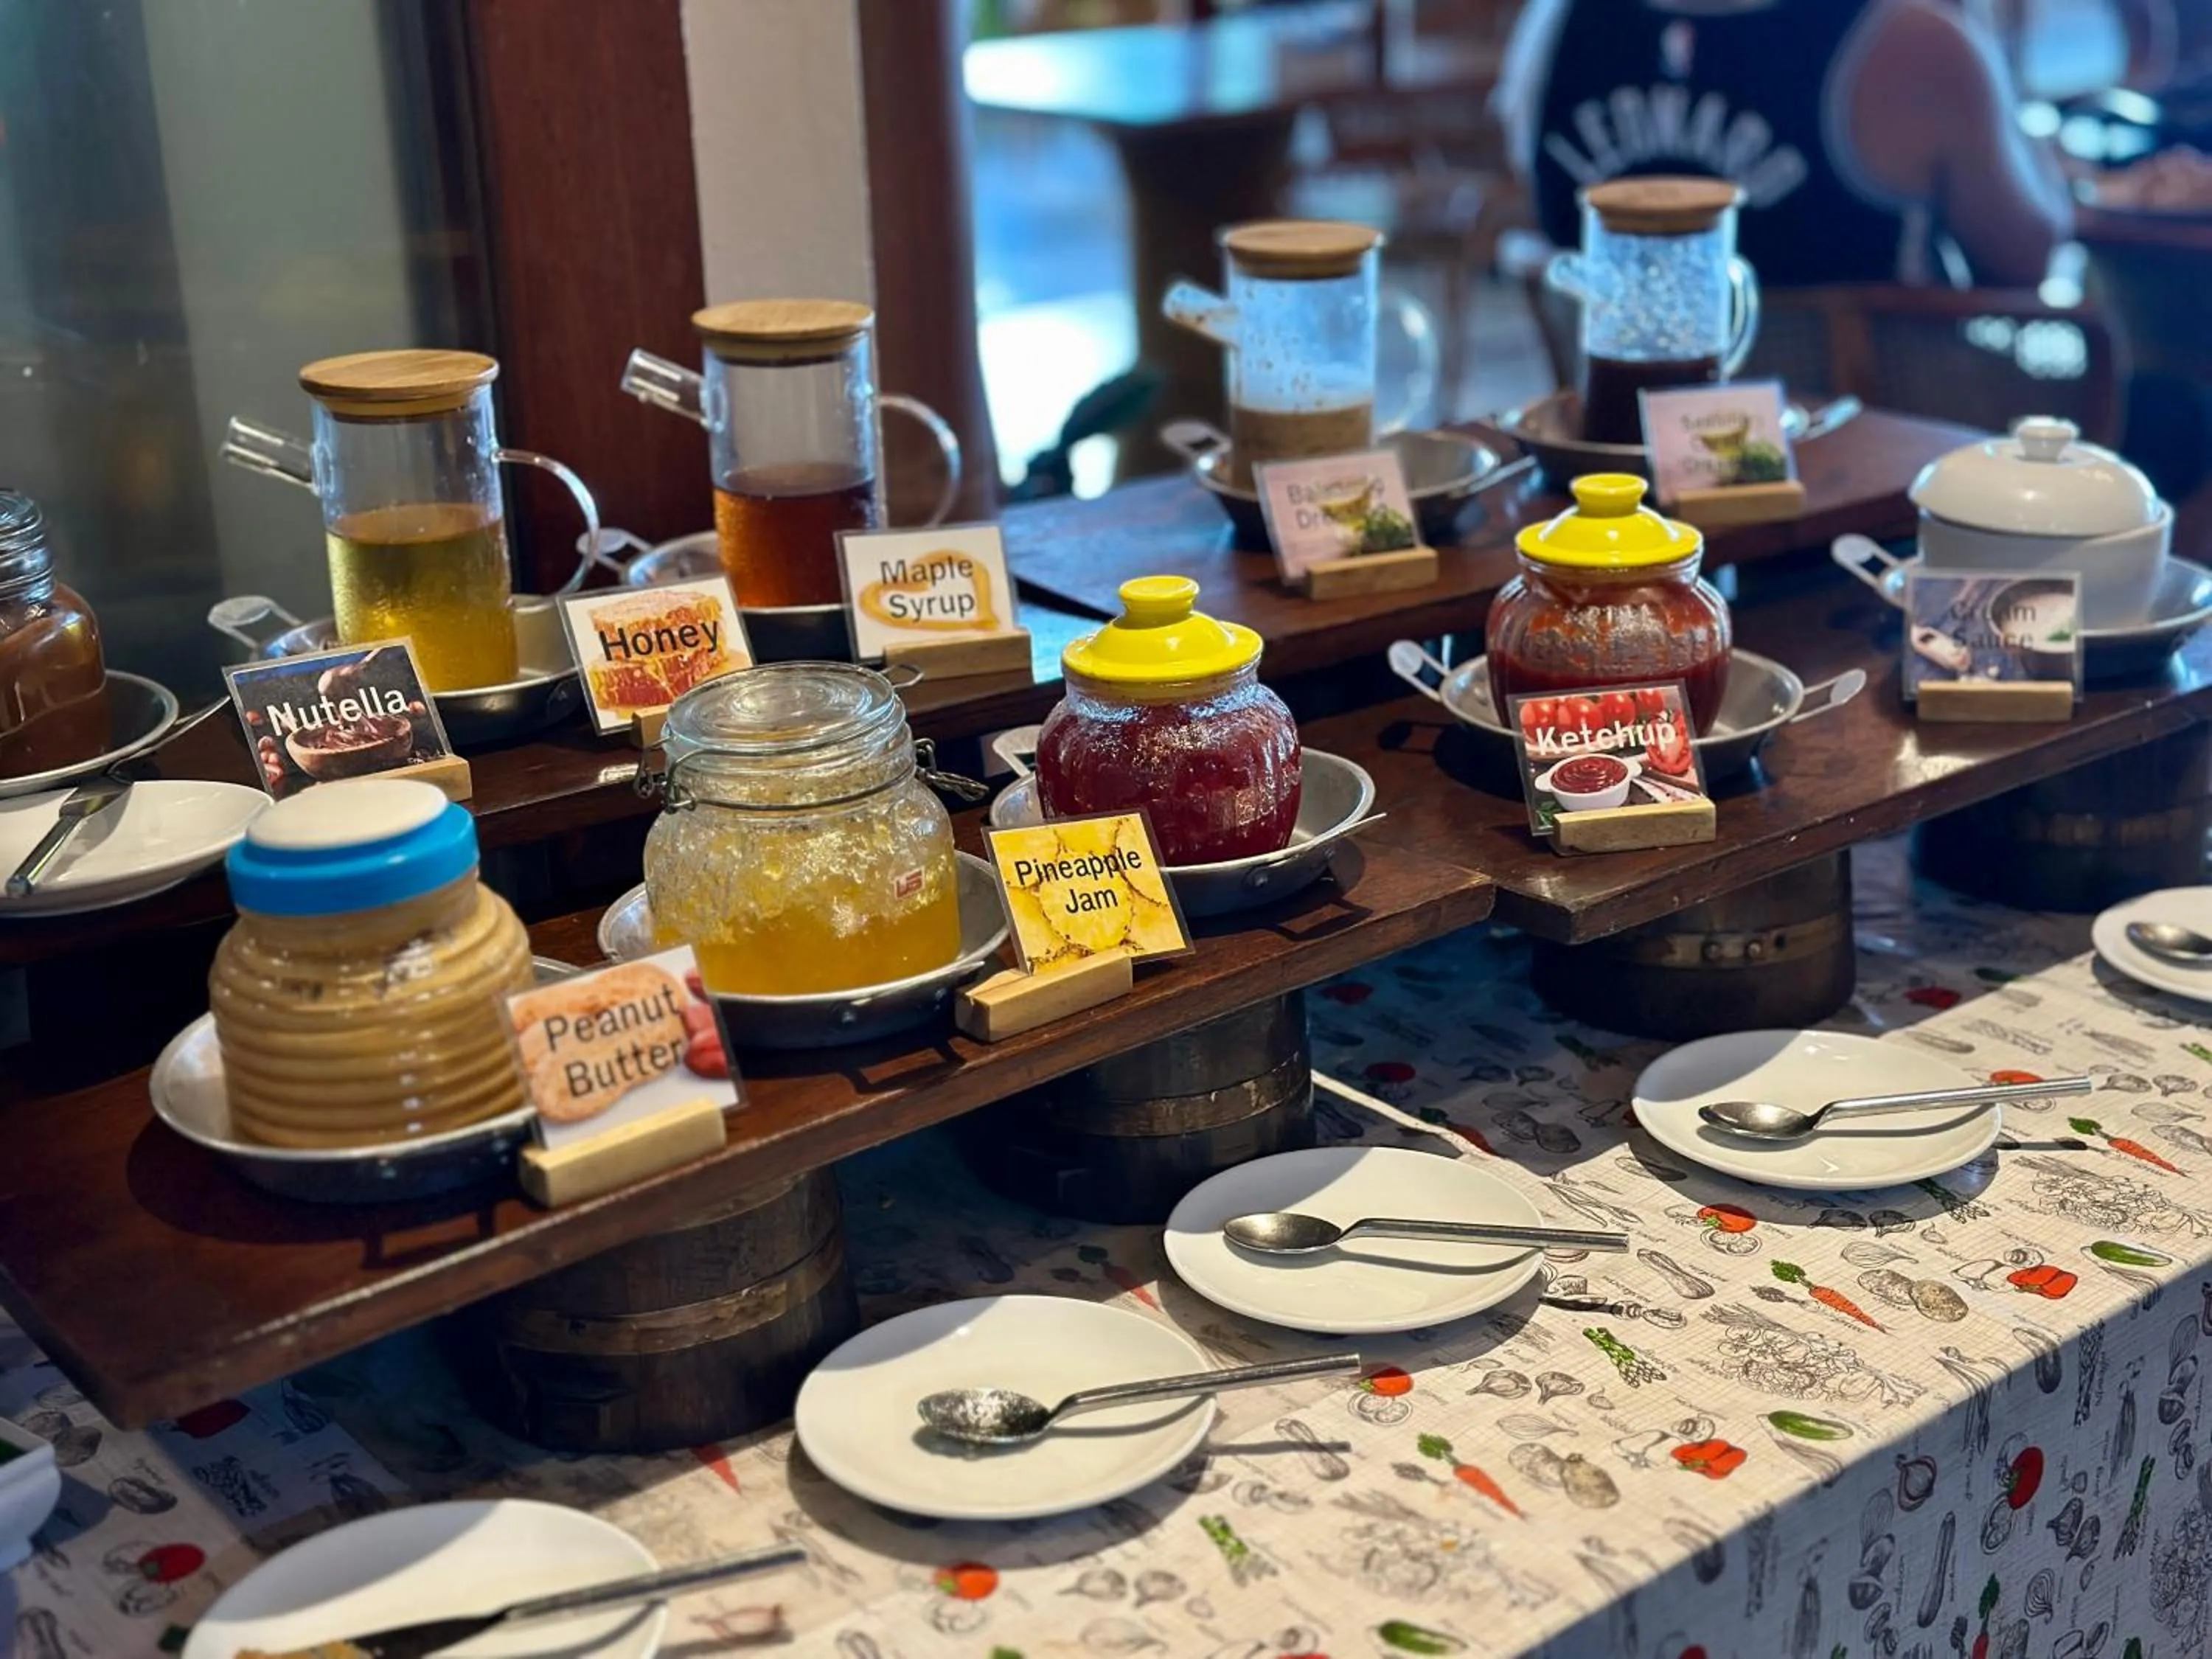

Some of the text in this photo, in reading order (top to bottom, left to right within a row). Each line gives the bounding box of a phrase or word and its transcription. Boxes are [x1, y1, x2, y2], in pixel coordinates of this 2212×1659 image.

[880, 555, 973, 586] Maple
[888, 592, 975, 622] Syrup
[1952, 603, 2037, 622] Crm
[599, 619, 718, 661] Honey
[266, 686, 410, 737] Nutella
[1535, 720, 1676, 756] Ketchup
[1014, 847, 1143, 886] Pineapple
[1065, 887, 1119, 914] Jam
[543, 983, 681, 1054] Peanut
[564, 1036, 684, 1098] Butter
